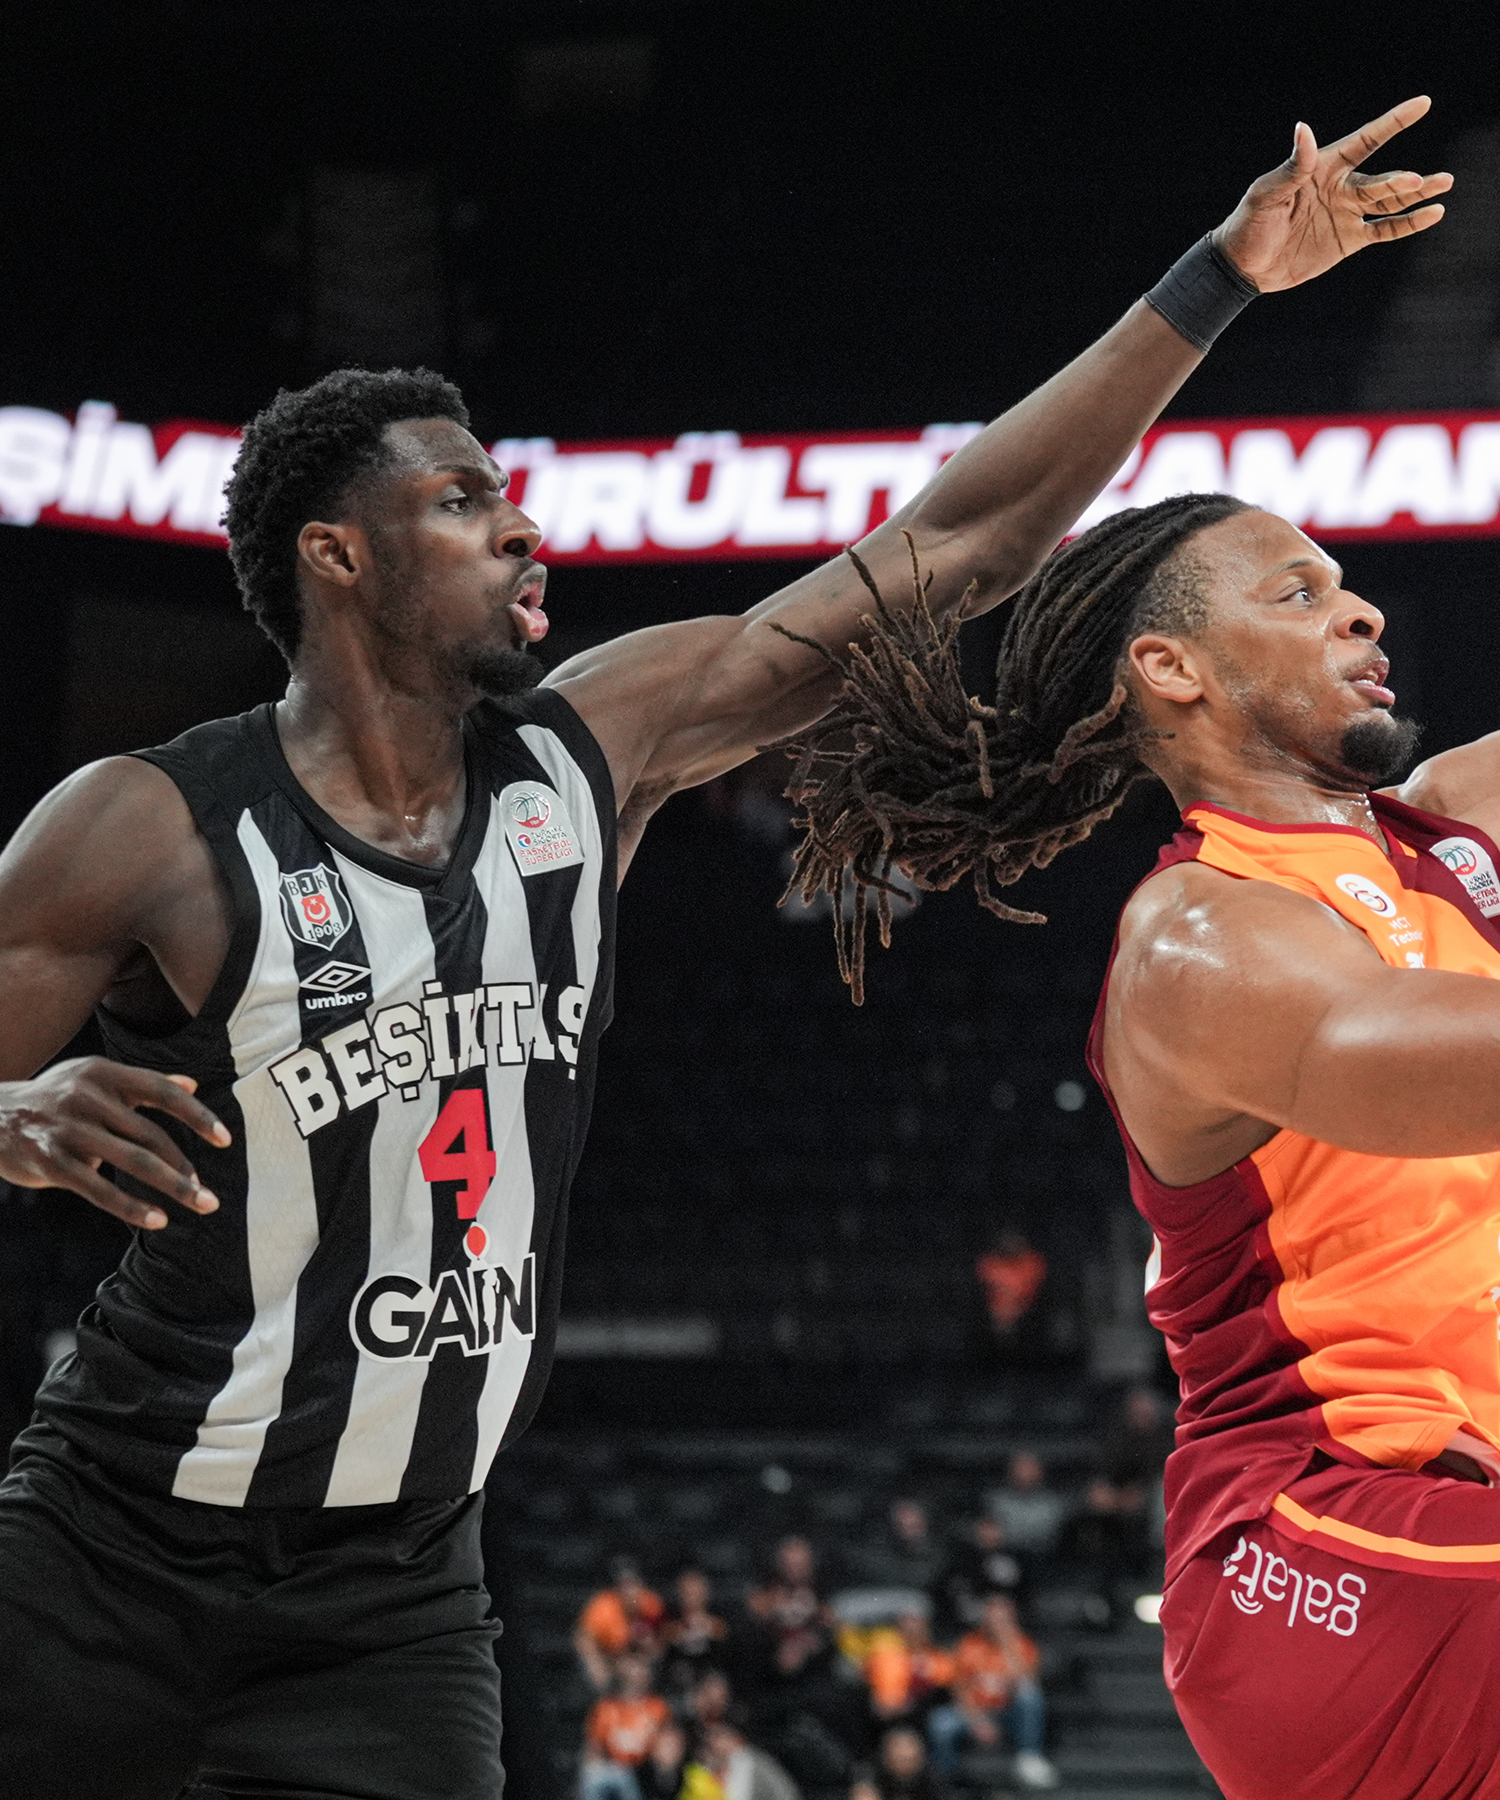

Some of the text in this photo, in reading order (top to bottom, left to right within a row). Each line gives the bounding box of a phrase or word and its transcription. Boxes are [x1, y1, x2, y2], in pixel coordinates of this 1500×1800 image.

[0, 400, 243, 534] ŞİM
[490, 422, 987, 551] ÜRÜLT
[287, 873, 329, 896] BJK
[307, 921, 343, 941] 1903
[305, 990, 368, 1010] umbro
[417, 1087, 497, 1220] 4
